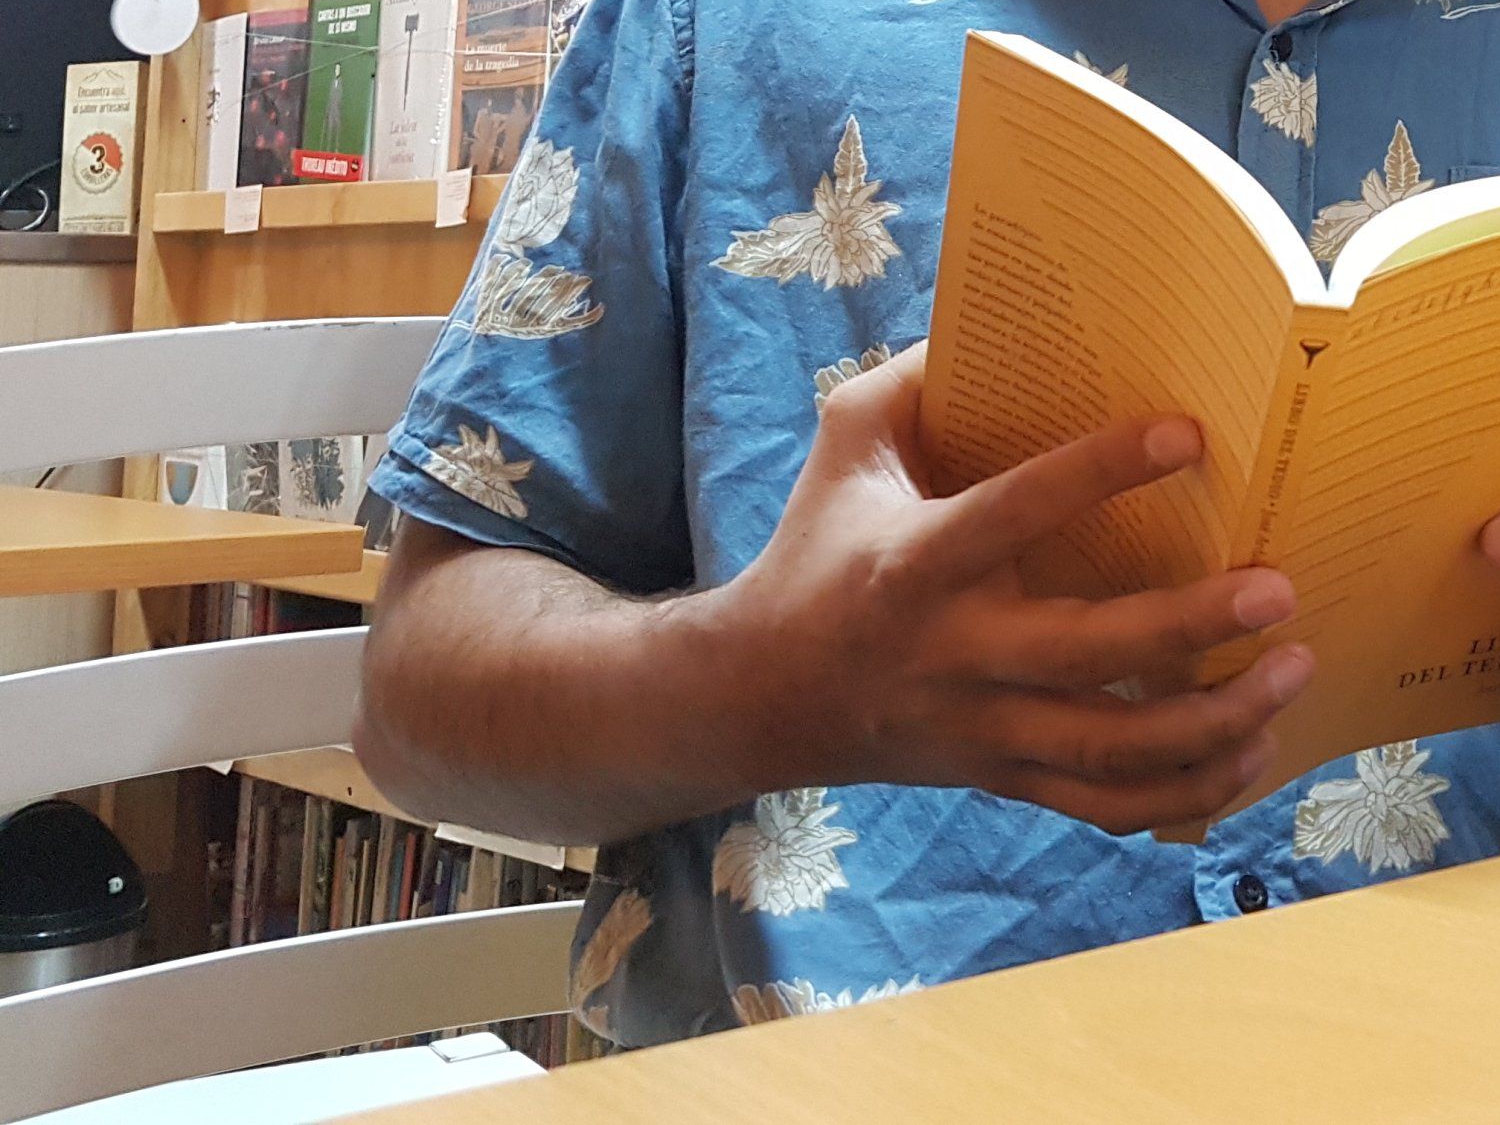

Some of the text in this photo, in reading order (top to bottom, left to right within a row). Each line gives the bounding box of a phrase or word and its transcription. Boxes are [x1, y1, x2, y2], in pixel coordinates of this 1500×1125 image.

[464, 55, 520, 73] de tragedia
[89, 144, 106, 175] 3
[1397, 663, 1452, 689] DEL
